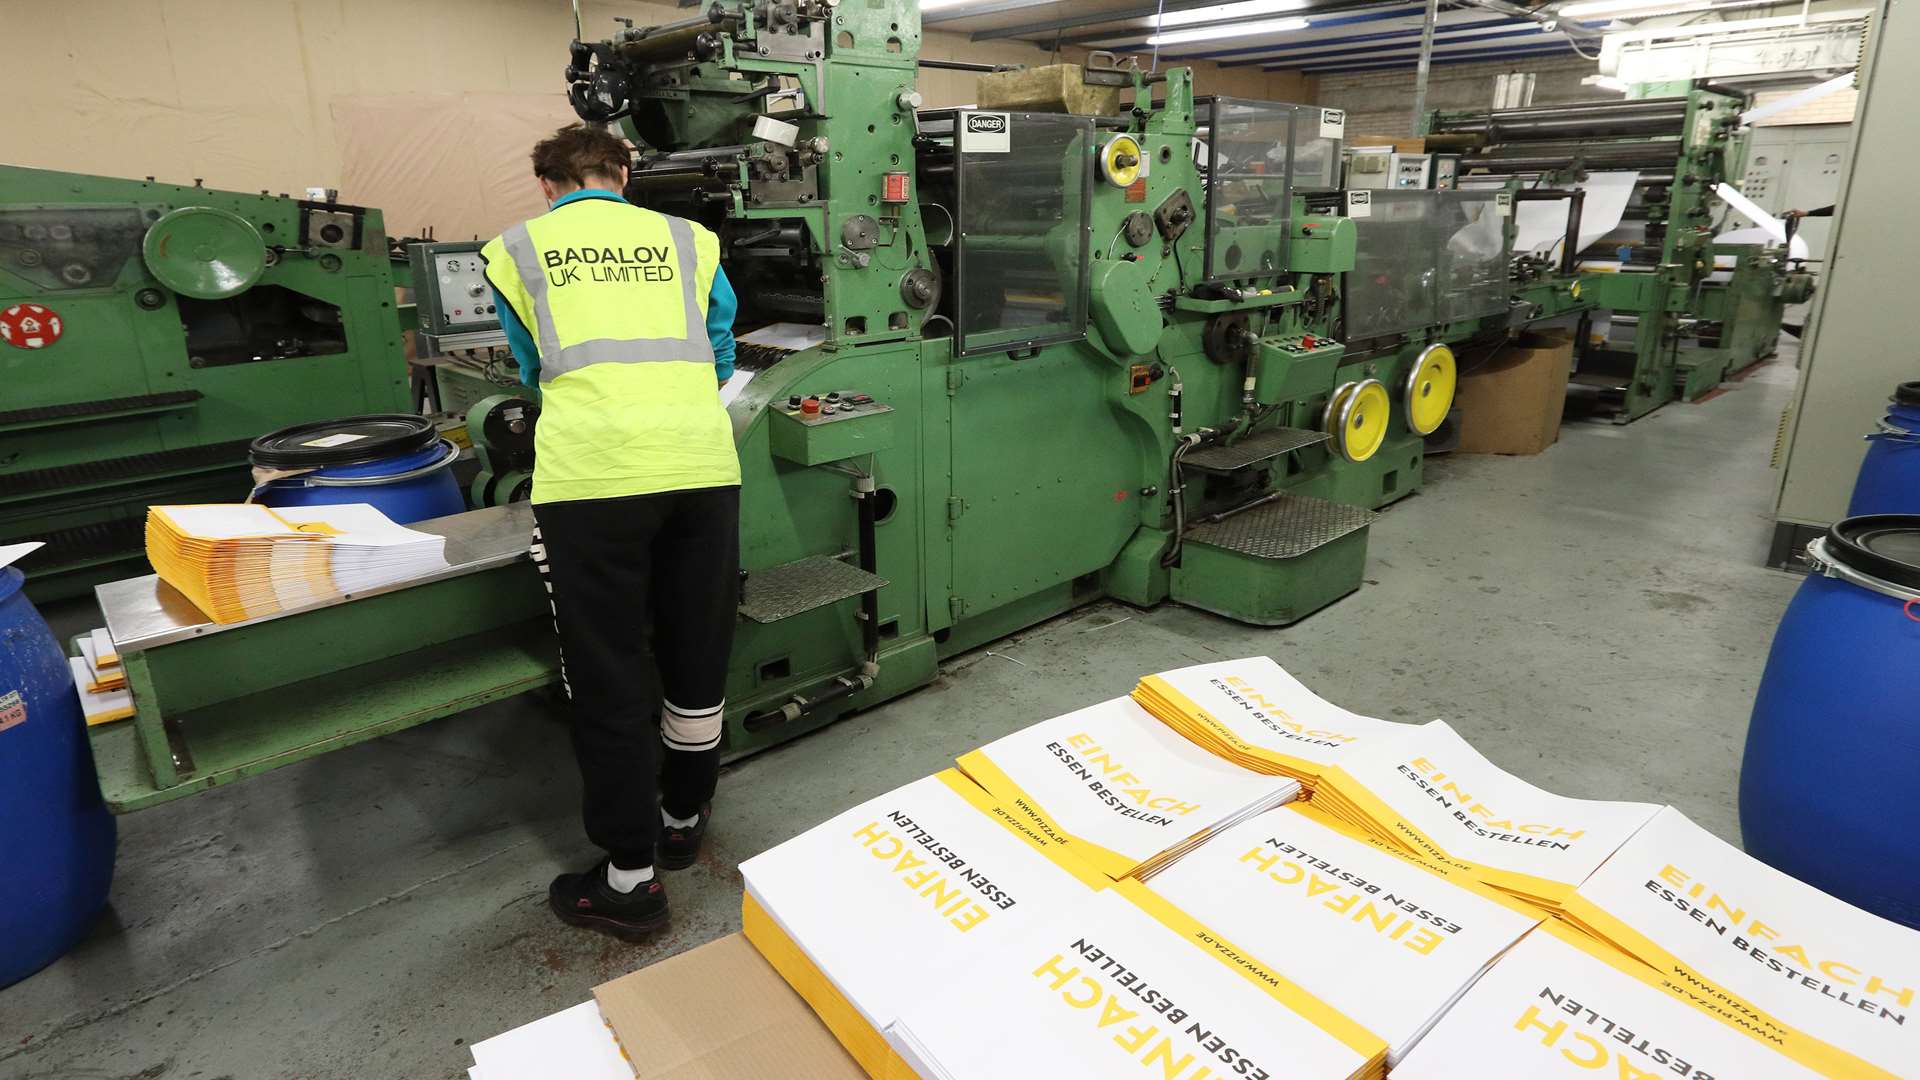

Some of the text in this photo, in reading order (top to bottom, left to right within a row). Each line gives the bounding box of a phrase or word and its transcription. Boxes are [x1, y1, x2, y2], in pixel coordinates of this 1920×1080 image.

[971, 119, 1002, 129] DANGER
[543, 246, 669, 268] BADALOV
[549, 265, 674, 287] UK LIMITED
[1209, 678, 1341, 748] ESSEN BESTELLEN
[1224, 675, 1359, 743] EINFACH
[1045, 741, 1174, 827] ESSEN BESTELLEN
[1066, 732, 1201, 816] EINFACH
[1396, 764, 1571, 850] ESSEN BESTELLEN
[1411, 757, 1587, 840] EINFACH
[887, 810, 1017, 910] ESSEN BESTELLEN
[992, 806, 1049, 847] WWW.PIZZA.DE
[1015, 798, 1069, 846] WWW.PIZZA.DE
[1396, 821, 1472, 871] WWW.PIZZA.DE
[852, 821, 991, 933] EINFACH
[1238, 847, 1445, 955] EINFACH
[1265, 837, 1463, 934] ESSEN BESTELLEN
[1196, 931, 1280, 987] WWW.PIZZA.DE
[1644, 880, 1906, 1026] ESSEN BESTELLEN
[1657, 863, 1915, 1008] EINFACH
[1070, 938, 1188, 1024] BESTELLEN
[1661, 979, 1785, 1046] WWW.PIZZA.DE
